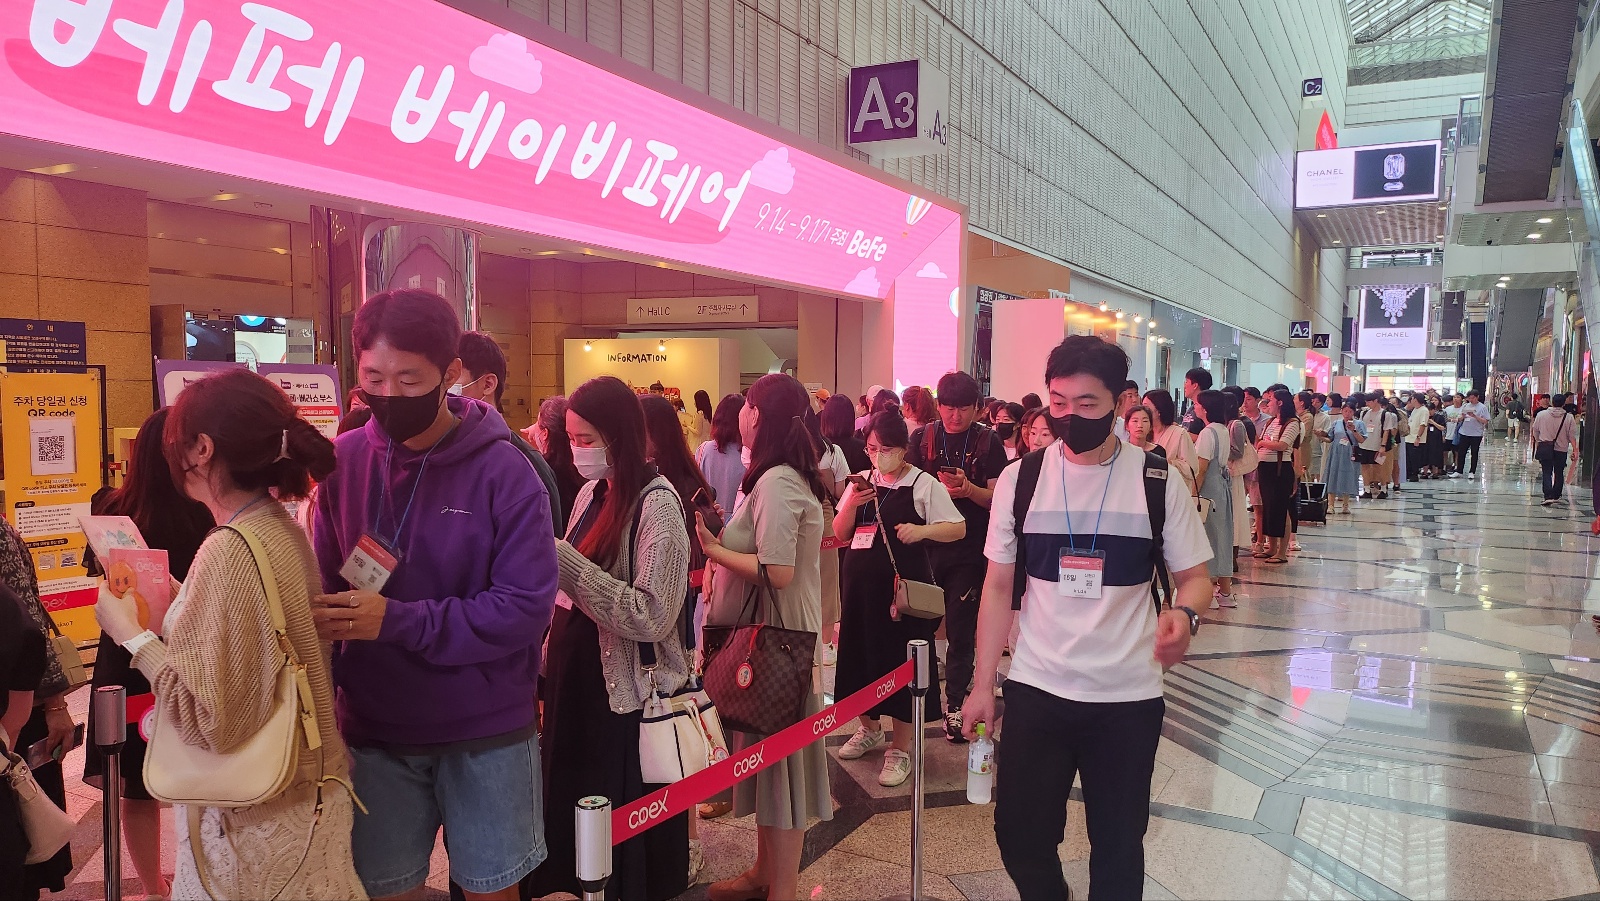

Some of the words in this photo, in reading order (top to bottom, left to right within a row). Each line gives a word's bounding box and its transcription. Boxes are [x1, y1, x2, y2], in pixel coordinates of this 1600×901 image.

[1304, 81, 1322, 95] C2
[853, 76, 915, 133] A3
[390, 64, 751, 232] 베이비페어
[1306, 168, 1344, 177] CHANEL
[830, 227, 850, 247] 주최
[846, 229, 888, 262] BeFe
[647, 306, 663, 316] Hall
[664, 306, 671, 316] C
[1290, 323, 1309, 337] A2
[1314, 335, 1329, 347] A1
[607, 353, 668, 364] INFORMATION
[13, 396, 34, 407] 주차
[36, 395, 66, 406] 당일권
[69, 395, 88, 406] 신청
[28, 408, 46, 417] QR
[49, 408, 76, 417] code
[44, 594, 68, 610] oex
[875, 672, 897, 700] coex
[812, 707, 838, 736] coex
[733, 744, 765, 779] coex
[628, 789, 670, 830] coex
